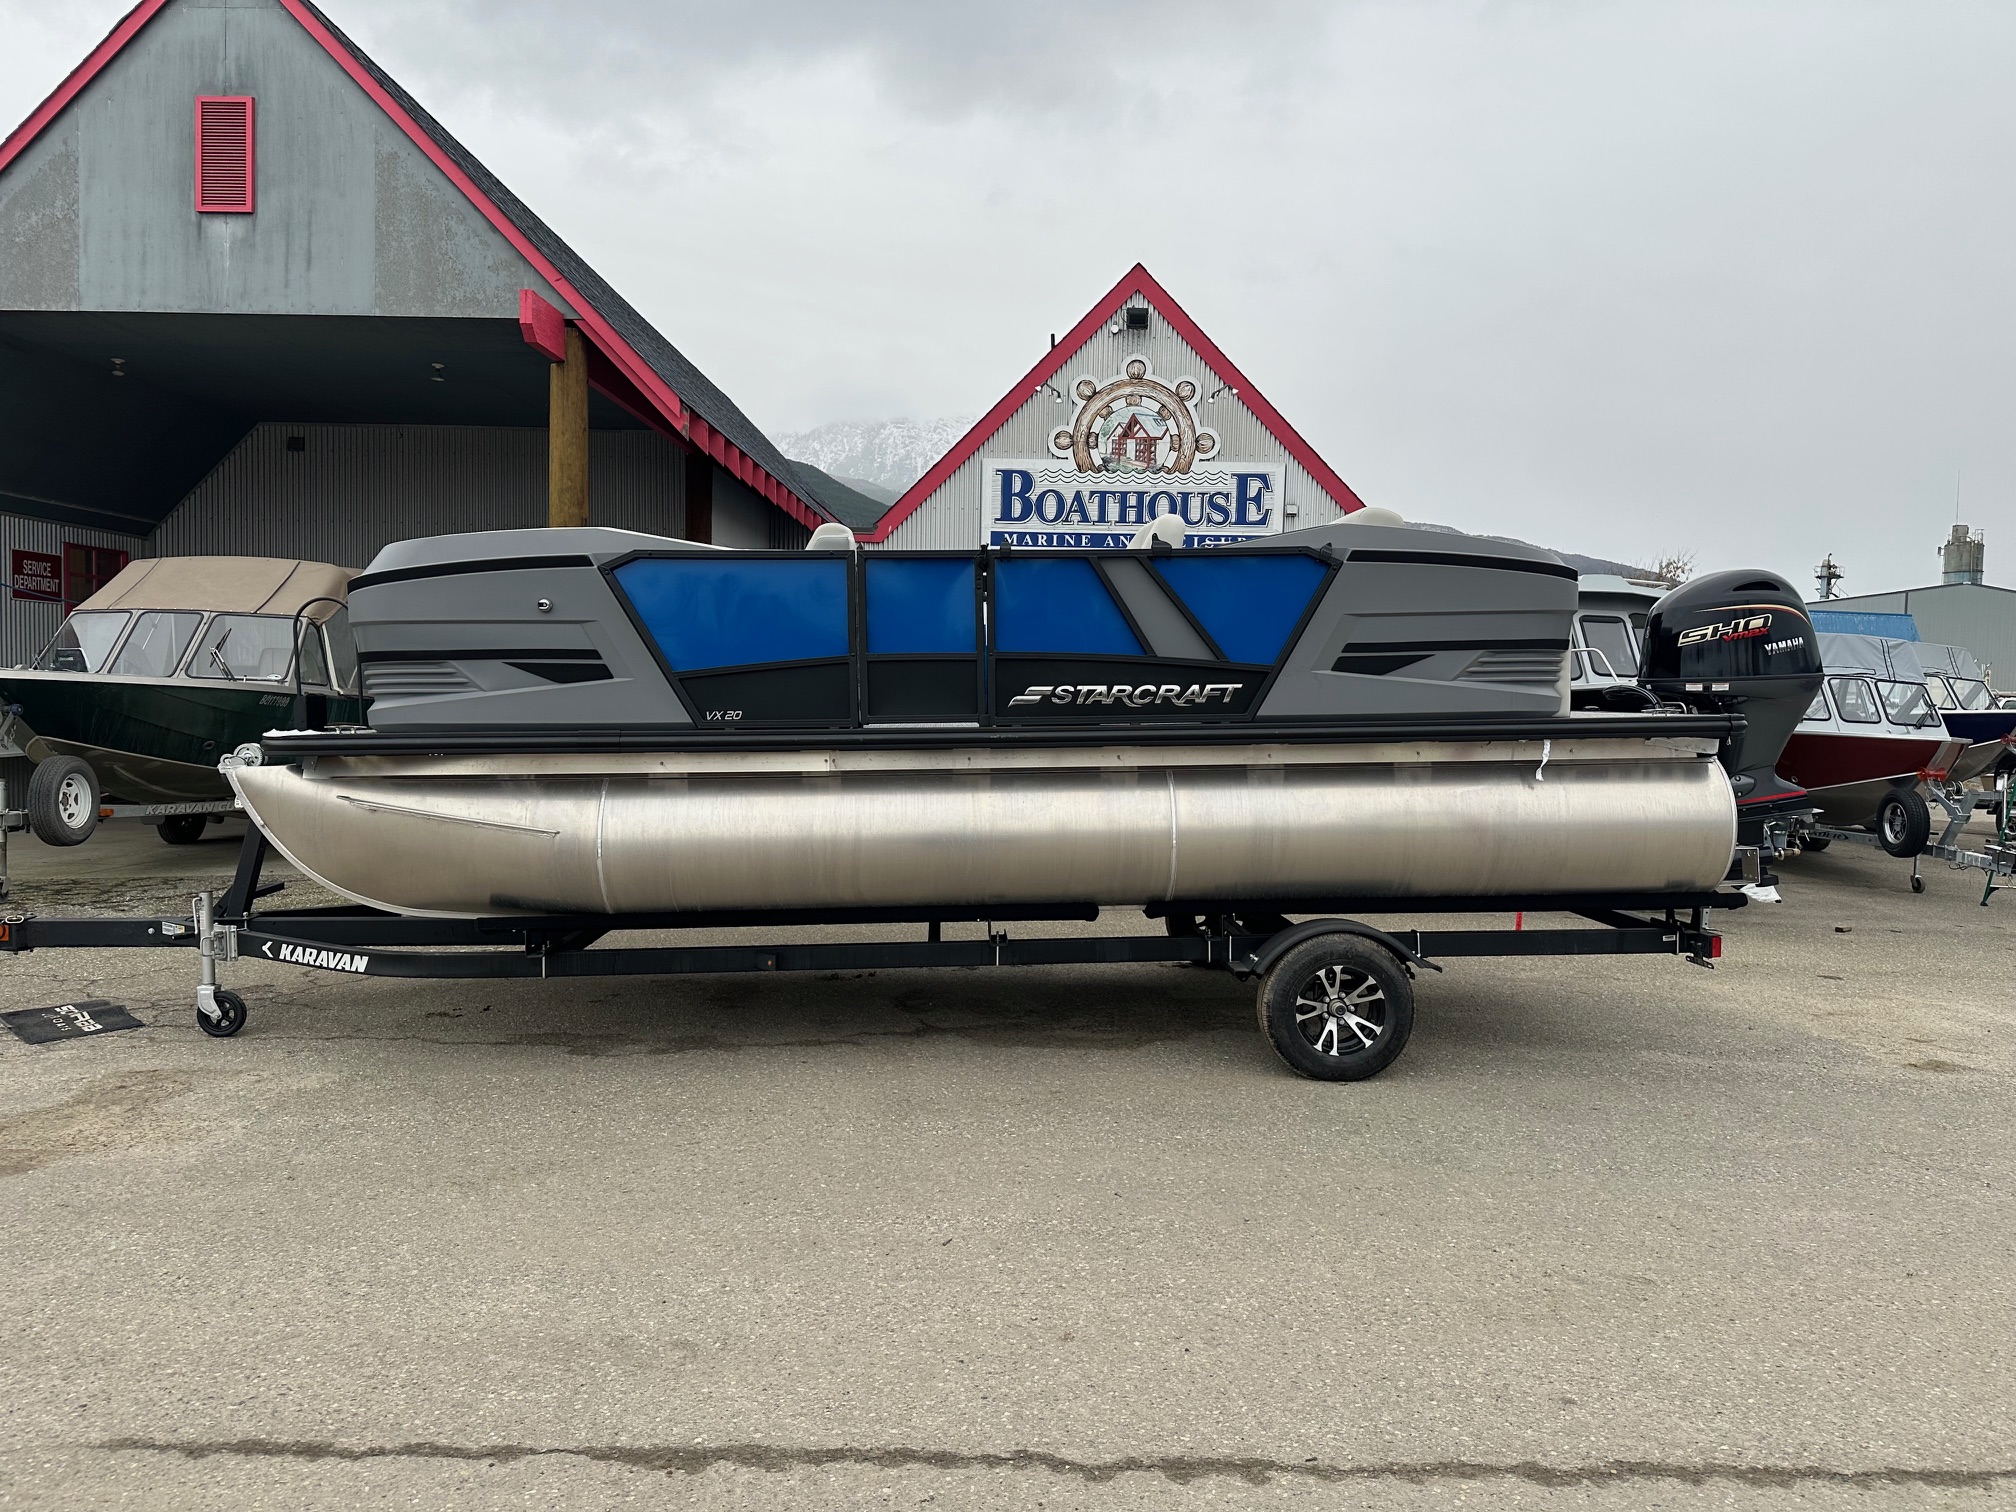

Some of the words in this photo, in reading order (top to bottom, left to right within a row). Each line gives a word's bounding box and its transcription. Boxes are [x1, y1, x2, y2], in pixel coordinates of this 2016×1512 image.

[1003, 533, 1091, 547] MARINE
[1103, 534, 1132, 548] AN
[23, 559, 52, 577] SERVICE
[14, 574, 60, 593] DEPARTMENT
[1677, 613, 1773, 647] SHO
[1764, 636, 1804, 655] YAMAHA
[1051, 683, 1243, 708] STARCRAFT
[706, 710, 724, 720] VX
[724, 710, 743, 720] 20
[146, 801, 214, 815] KARAVAN
[279, 943, 369, 973] KARAVAN
